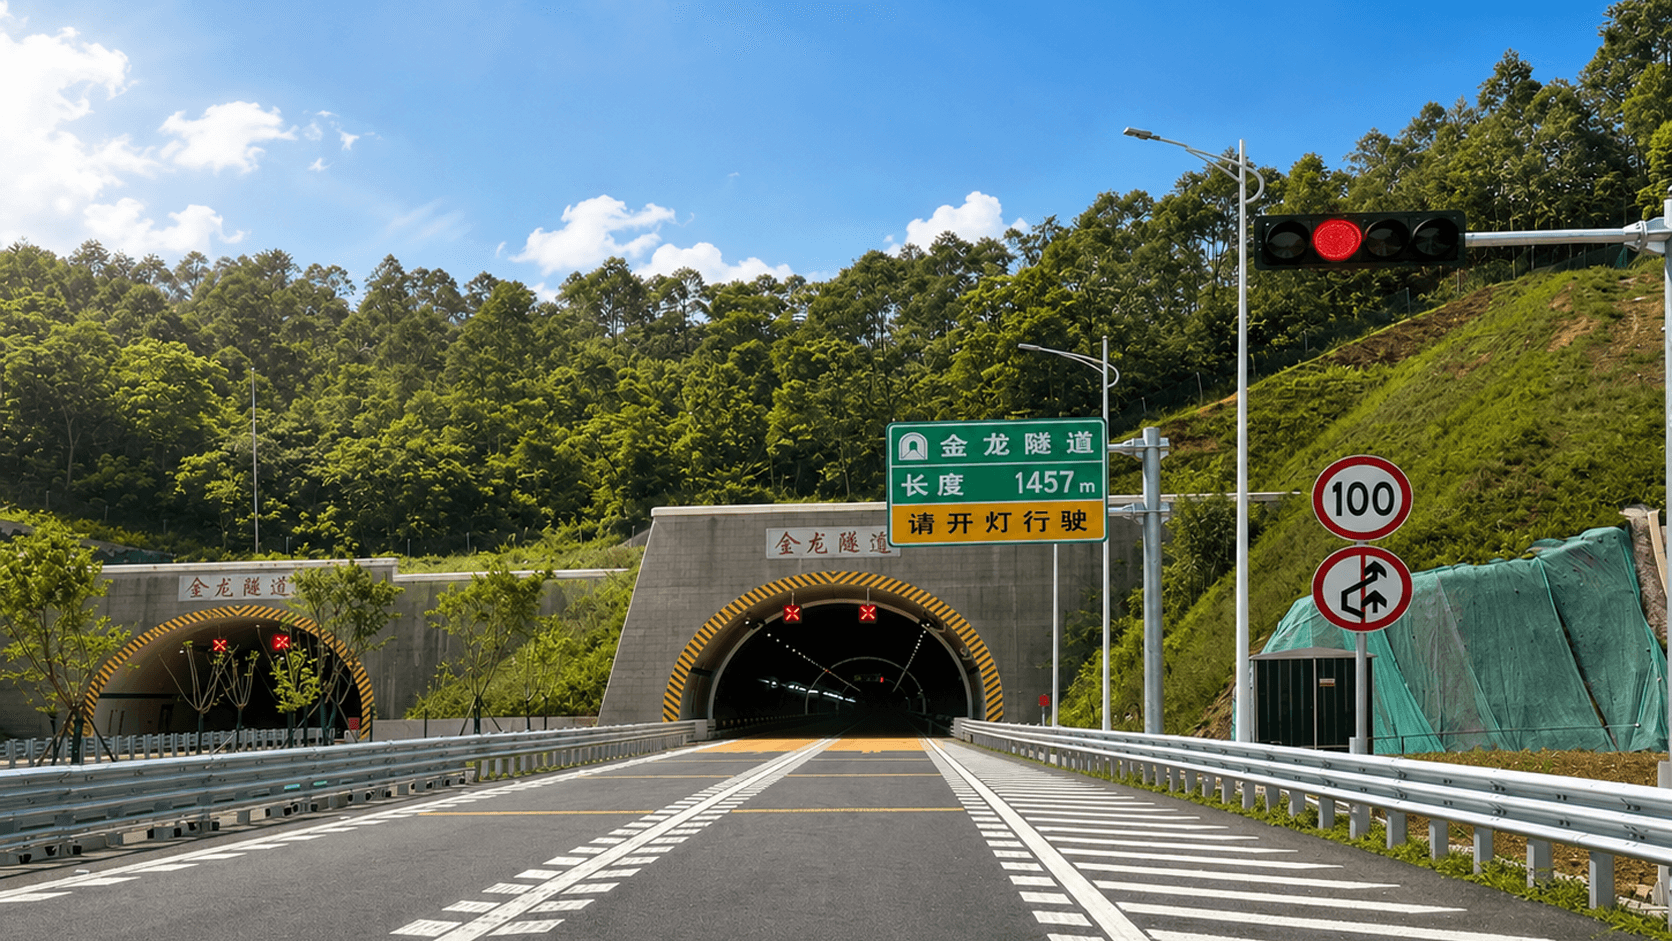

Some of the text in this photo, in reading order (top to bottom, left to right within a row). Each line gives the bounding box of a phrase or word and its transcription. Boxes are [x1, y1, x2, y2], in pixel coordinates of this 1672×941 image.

[940, 431, 1094, 457] 金龙隧道
[901, 471, 1095, 497] 长度 1457 m
[1332, 481, 1394, 516] 100
[908, 509, 1088, 535] 请开灯行驶
[775, 531, 892, 555] 金龙隧道
[185, 576, 290, 598] 金龙隧道
